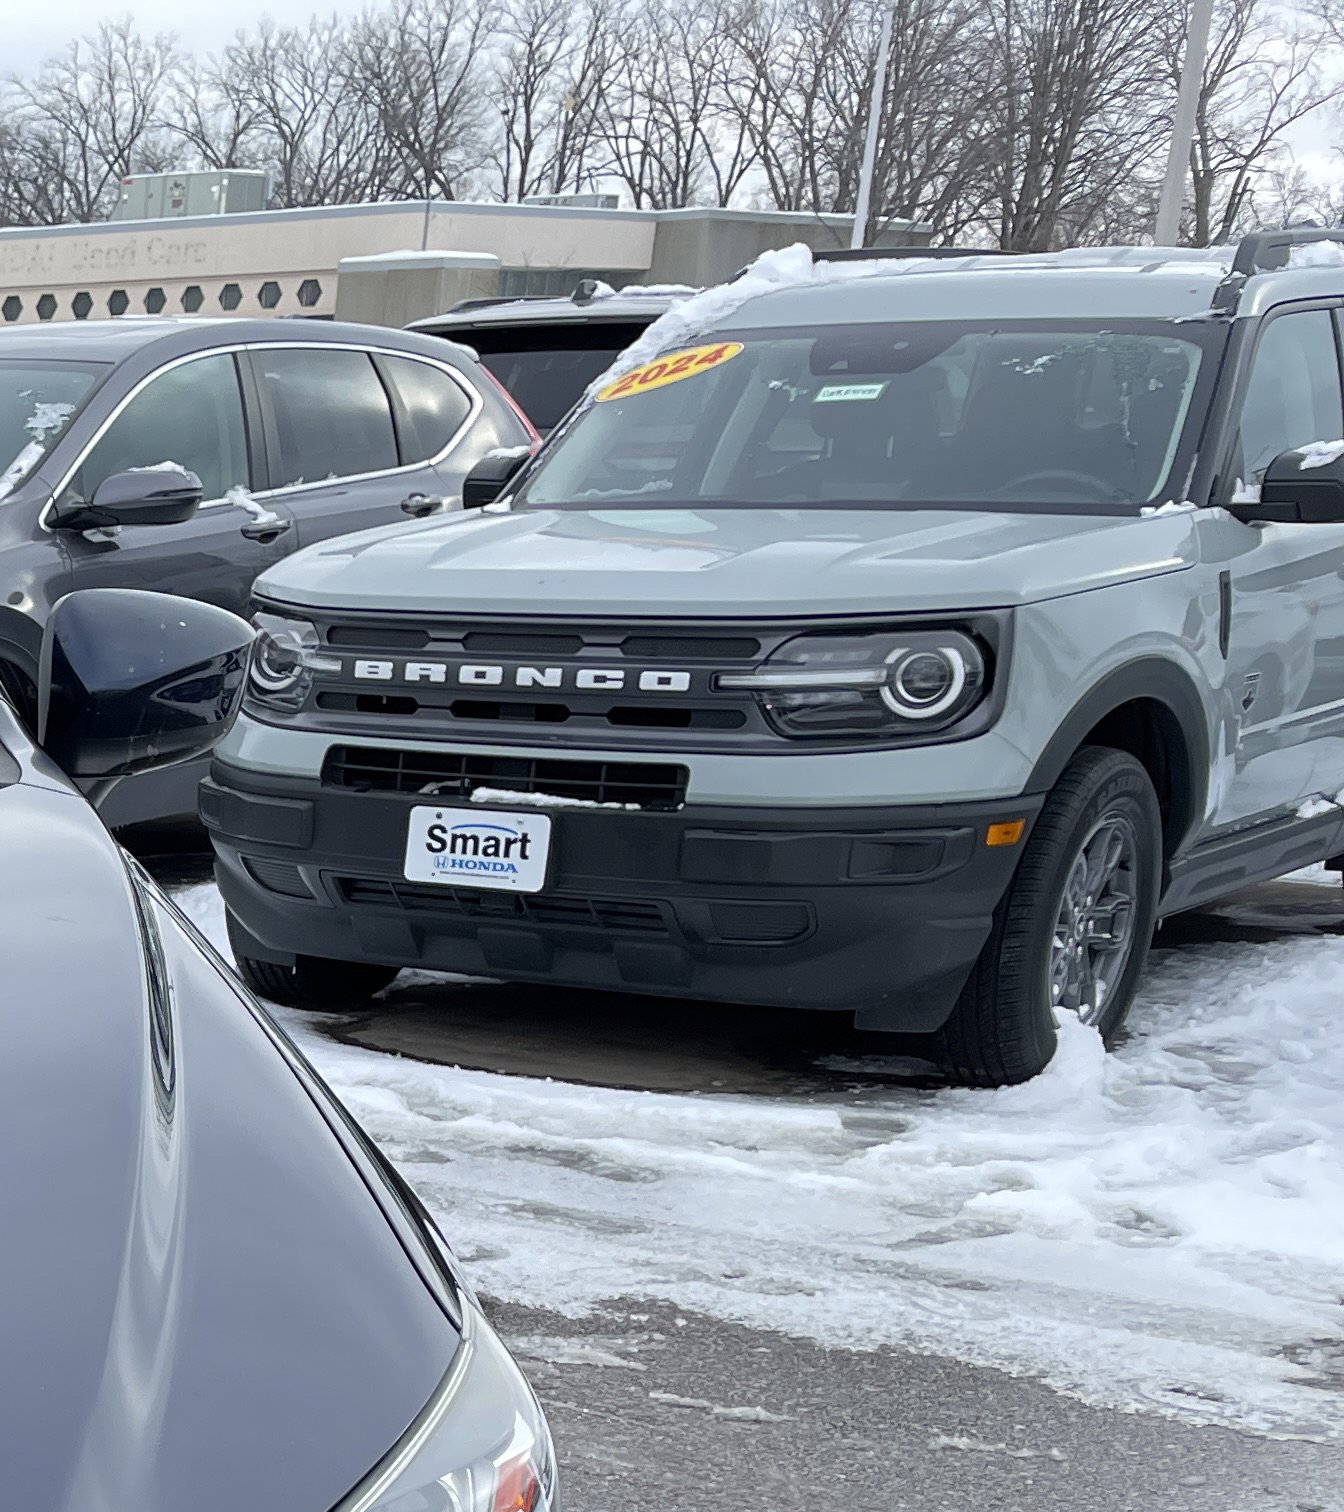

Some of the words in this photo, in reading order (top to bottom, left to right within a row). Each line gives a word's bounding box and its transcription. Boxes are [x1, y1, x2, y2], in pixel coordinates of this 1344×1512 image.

[608, 344, 729, 398] 2024
[354, 659, 690, 691] BRONCO
[426, 824, 531, 860] Smart
[450, 858, 519, 874] HONDA
